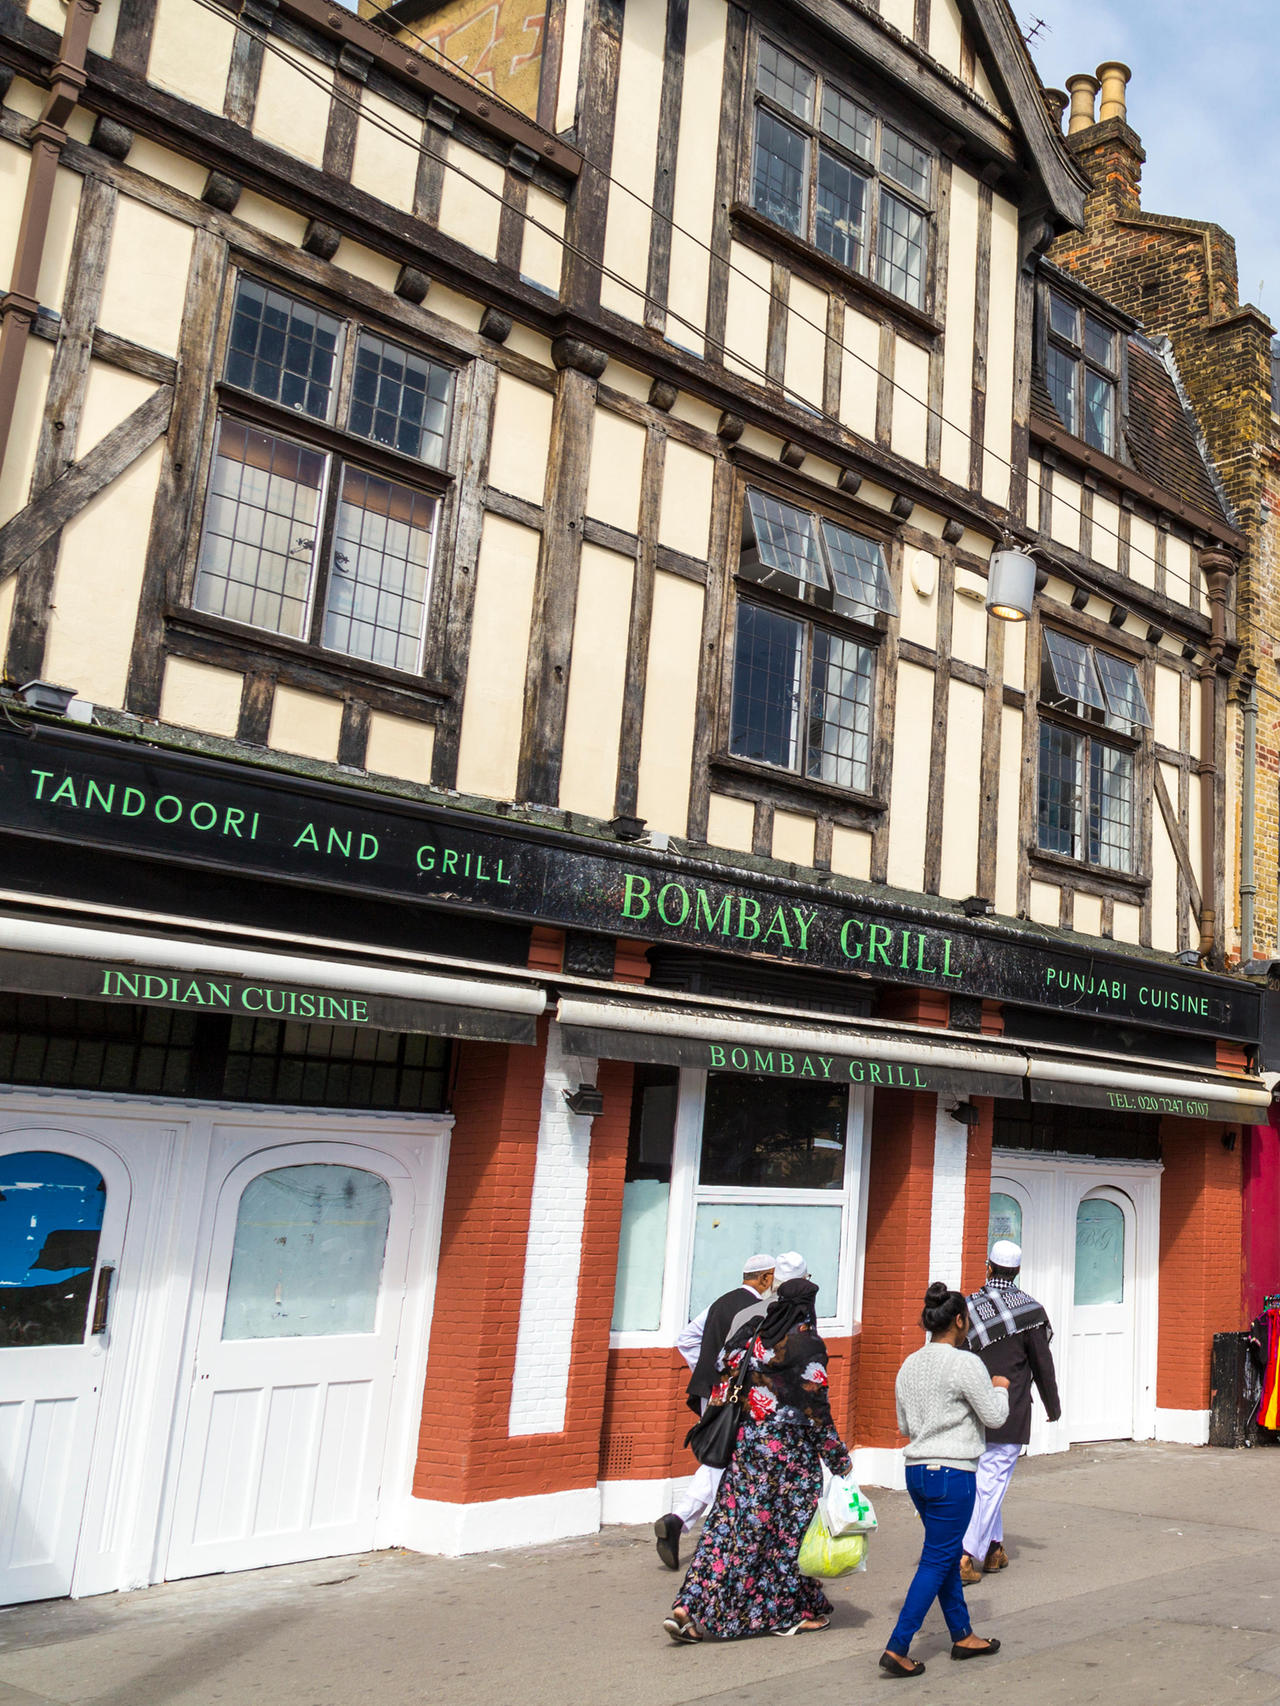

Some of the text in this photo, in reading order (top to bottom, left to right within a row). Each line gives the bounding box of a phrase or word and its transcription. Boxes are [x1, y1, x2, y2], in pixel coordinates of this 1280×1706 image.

[30, 768, 511, 885] TANDOORI AND GRILL
[620, 873, 963, 978] BOMBAY GRILL
[100, 970, 370, 1023] INDIAN CUISINE
[1046, 967, 1210, 1017] PUNJABI CUISINE
[708, 1045, 929, 1089] BOMBAY GRILL
[1107, 1092, 1209, 1117] TEL: 020 7247 6707
